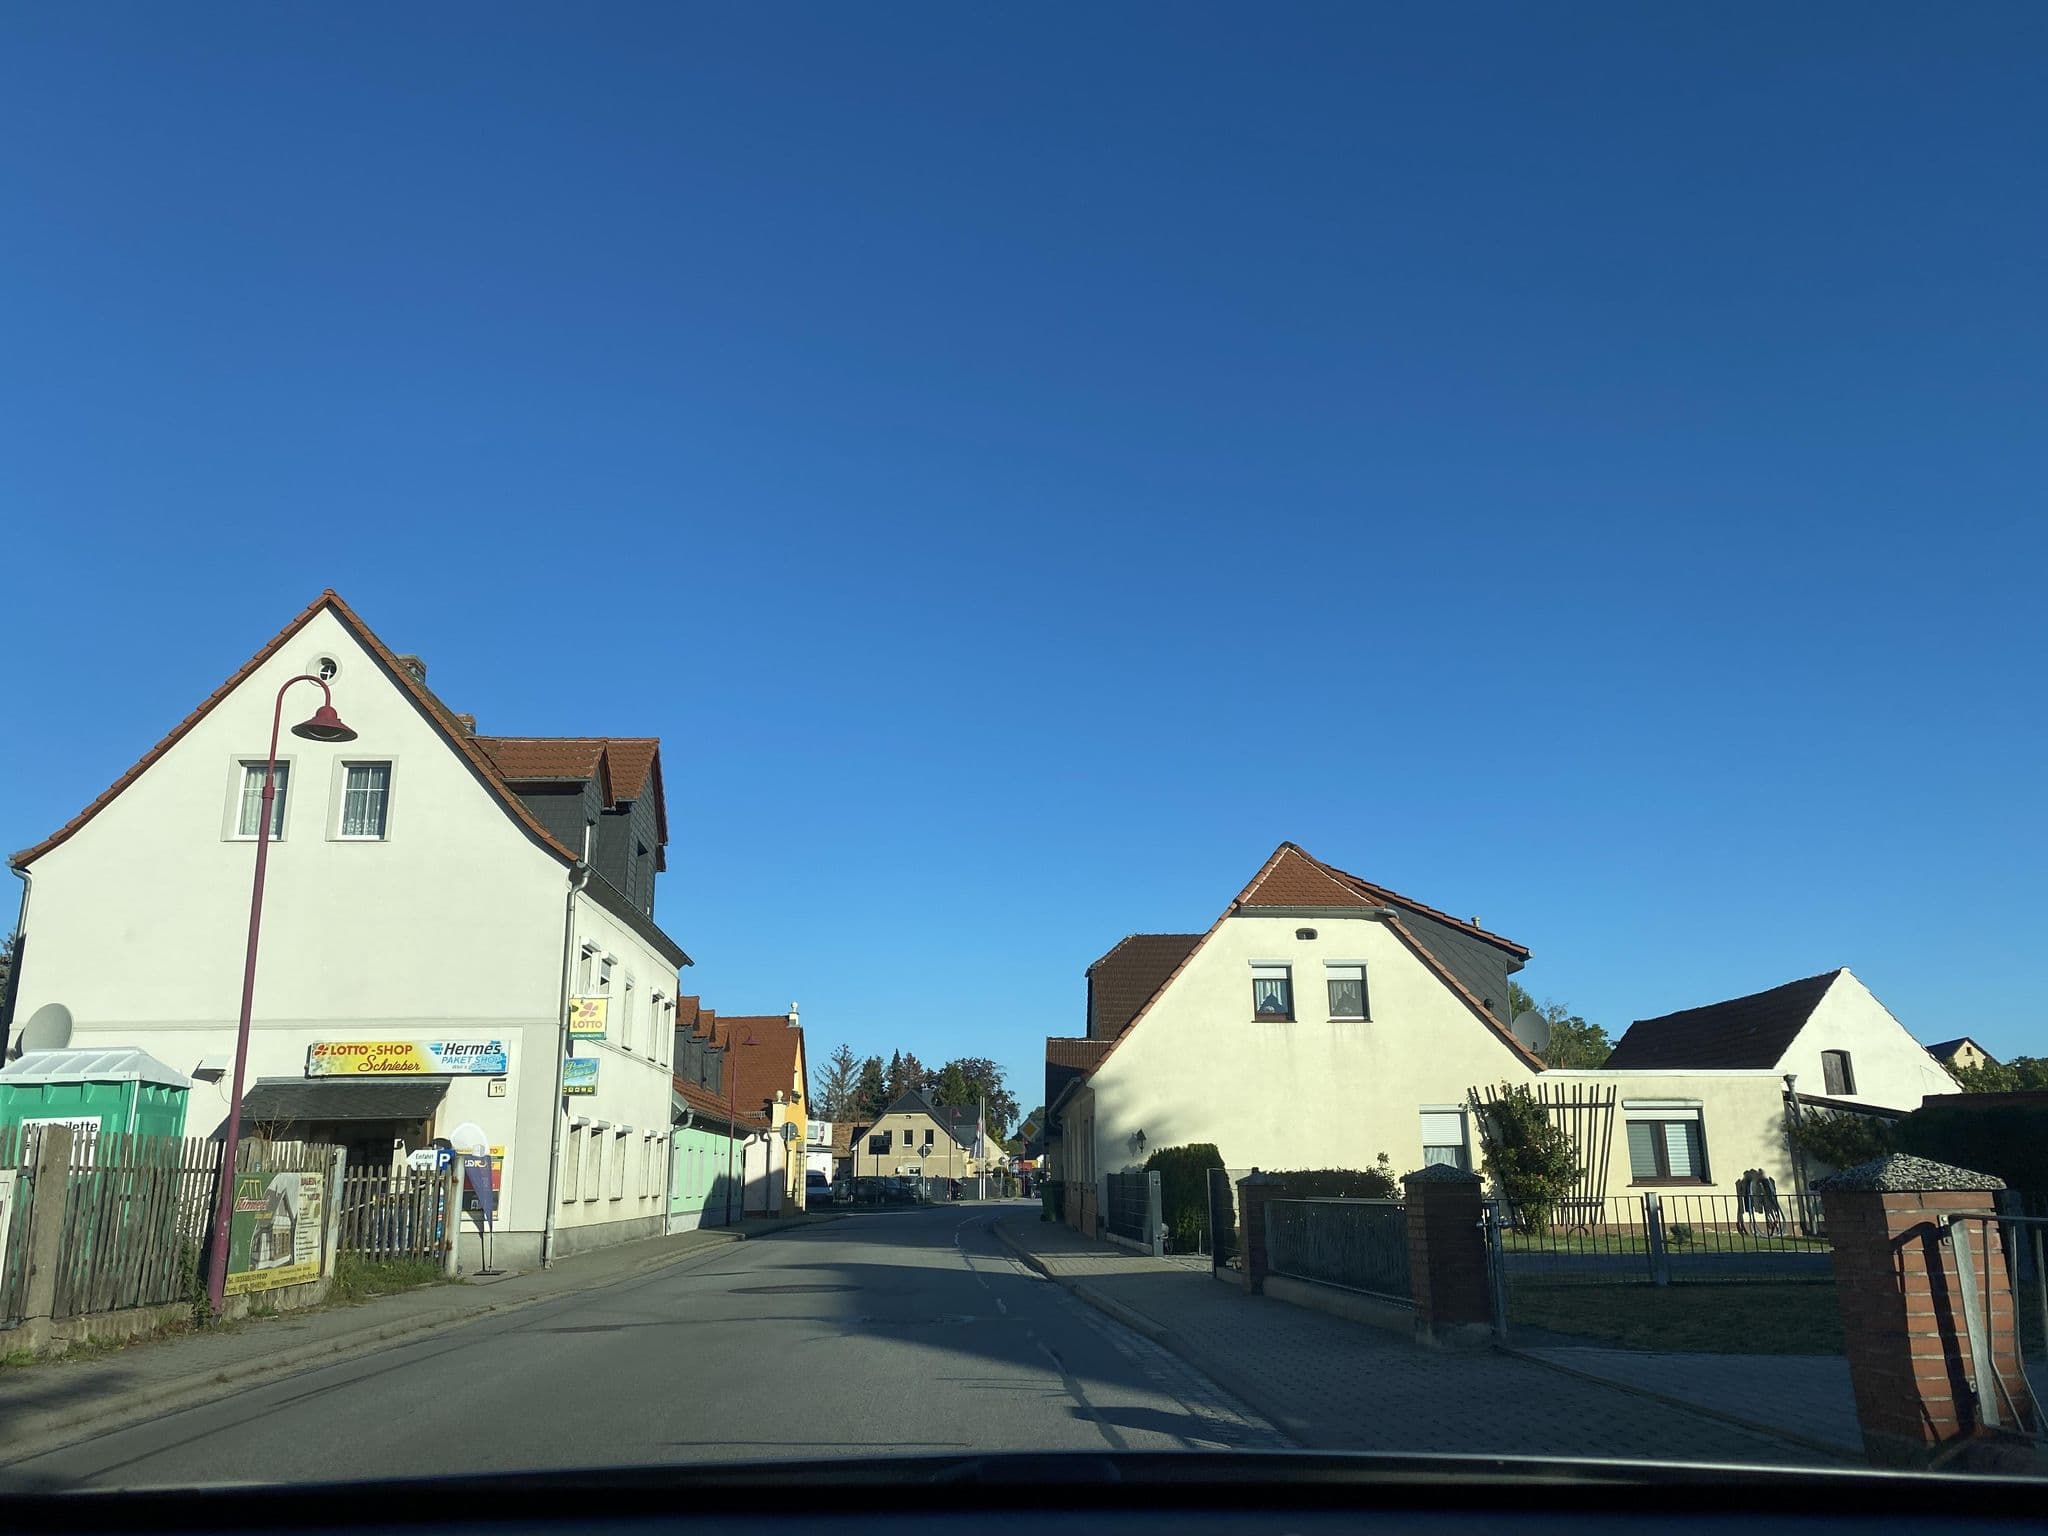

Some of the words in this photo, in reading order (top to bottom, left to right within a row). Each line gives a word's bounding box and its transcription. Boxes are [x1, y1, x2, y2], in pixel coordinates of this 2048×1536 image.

[572, 1020, 603, 1029] LOTTO
[443, 1043, 502, 1056] Hermes
[357, 1054, 420, 1072] Schnieber
[441, 1056, 473, 1064] PAKET
[474, 1055, 502, 1064] SHOP
[439, 1153, 451, 1168] P
